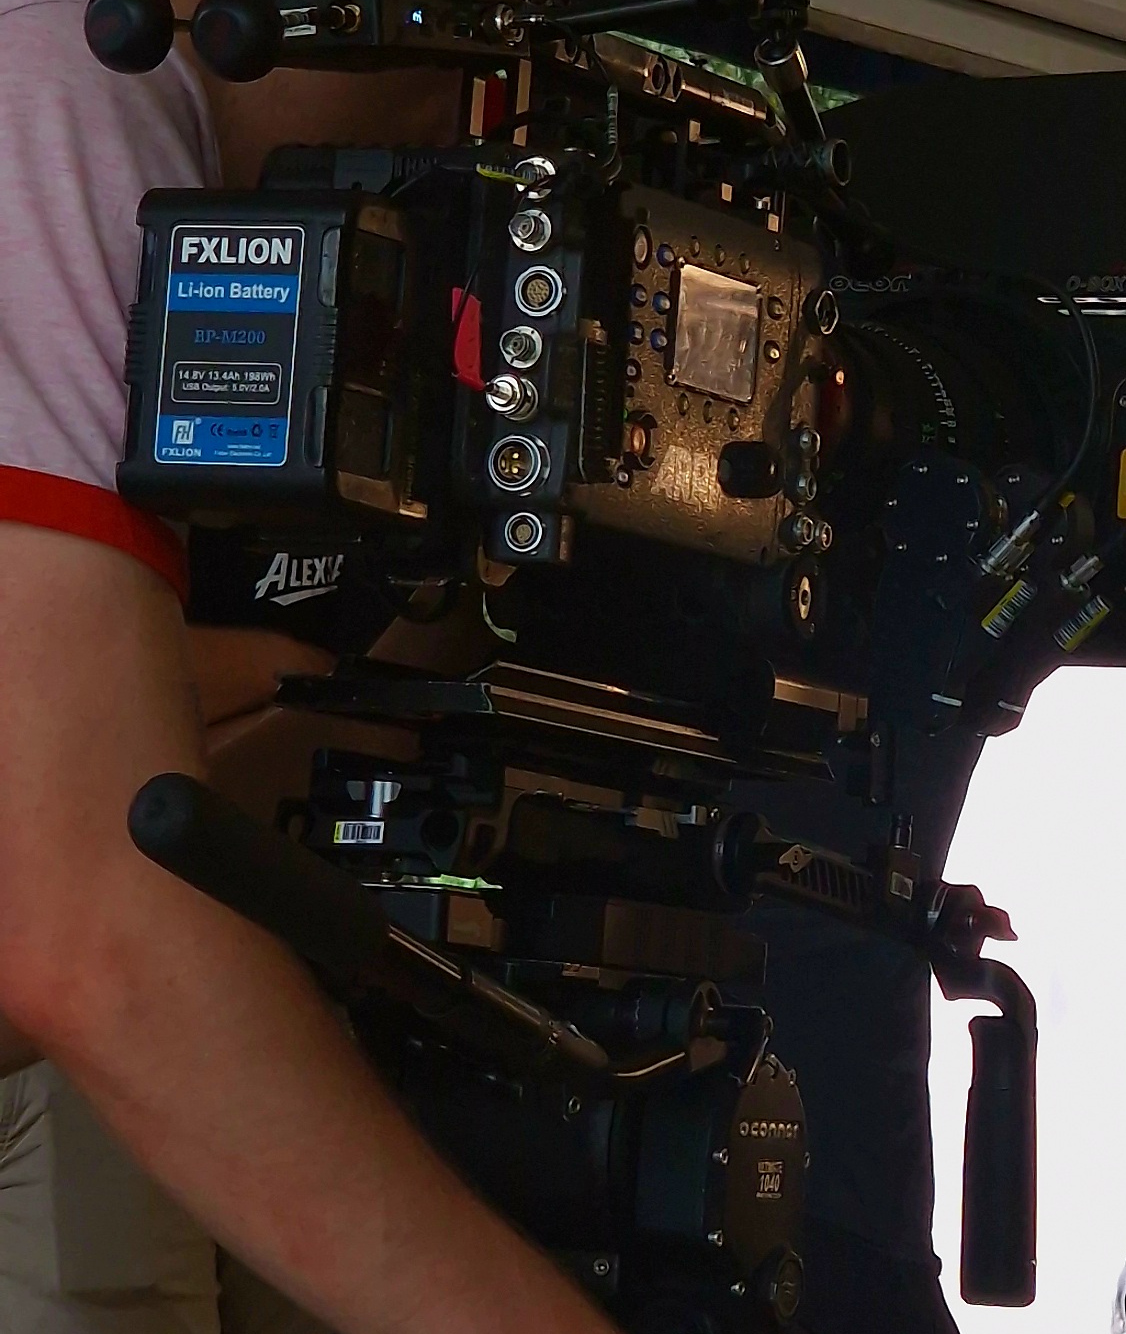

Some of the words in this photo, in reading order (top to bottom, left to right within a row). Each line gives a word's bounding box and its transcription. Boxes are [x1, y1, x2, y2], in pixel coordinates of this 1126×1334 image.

[181, 237, 293, 264] FXLION
[177, 282, 225, 298] Li-ion
[229, 282, 290, 303] Battery
[194, 329, 266, 344] BP-M200
[162, 447, 202, 457] FXLION
[760, 1174, 781, 1193] 1040
